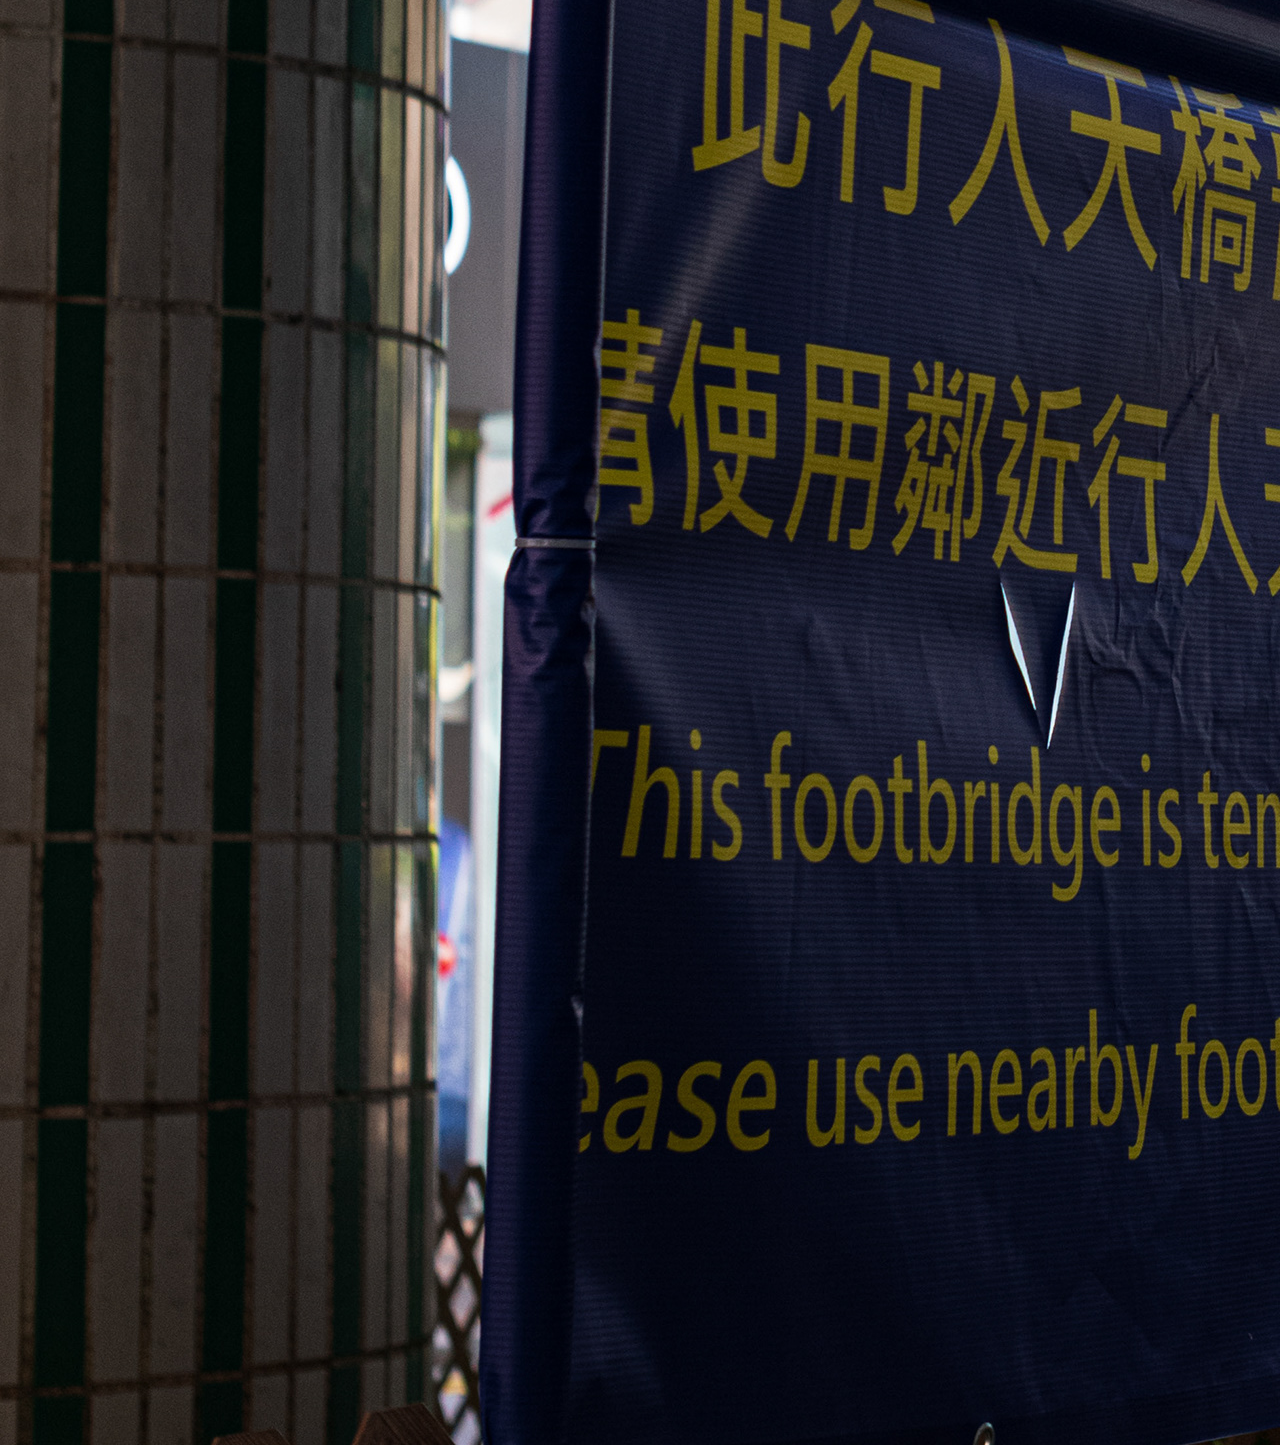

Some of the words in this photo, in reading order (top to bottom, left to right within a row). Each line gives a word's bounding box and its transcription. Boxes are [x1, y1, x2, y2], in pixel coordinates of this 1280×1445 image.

[765, 731, 1122, 903] footbridge
[1141, 754, 1183, 869] is
[807, 1053, 924, 1148] use
[948, 1008, 1159, 1160] nearby
